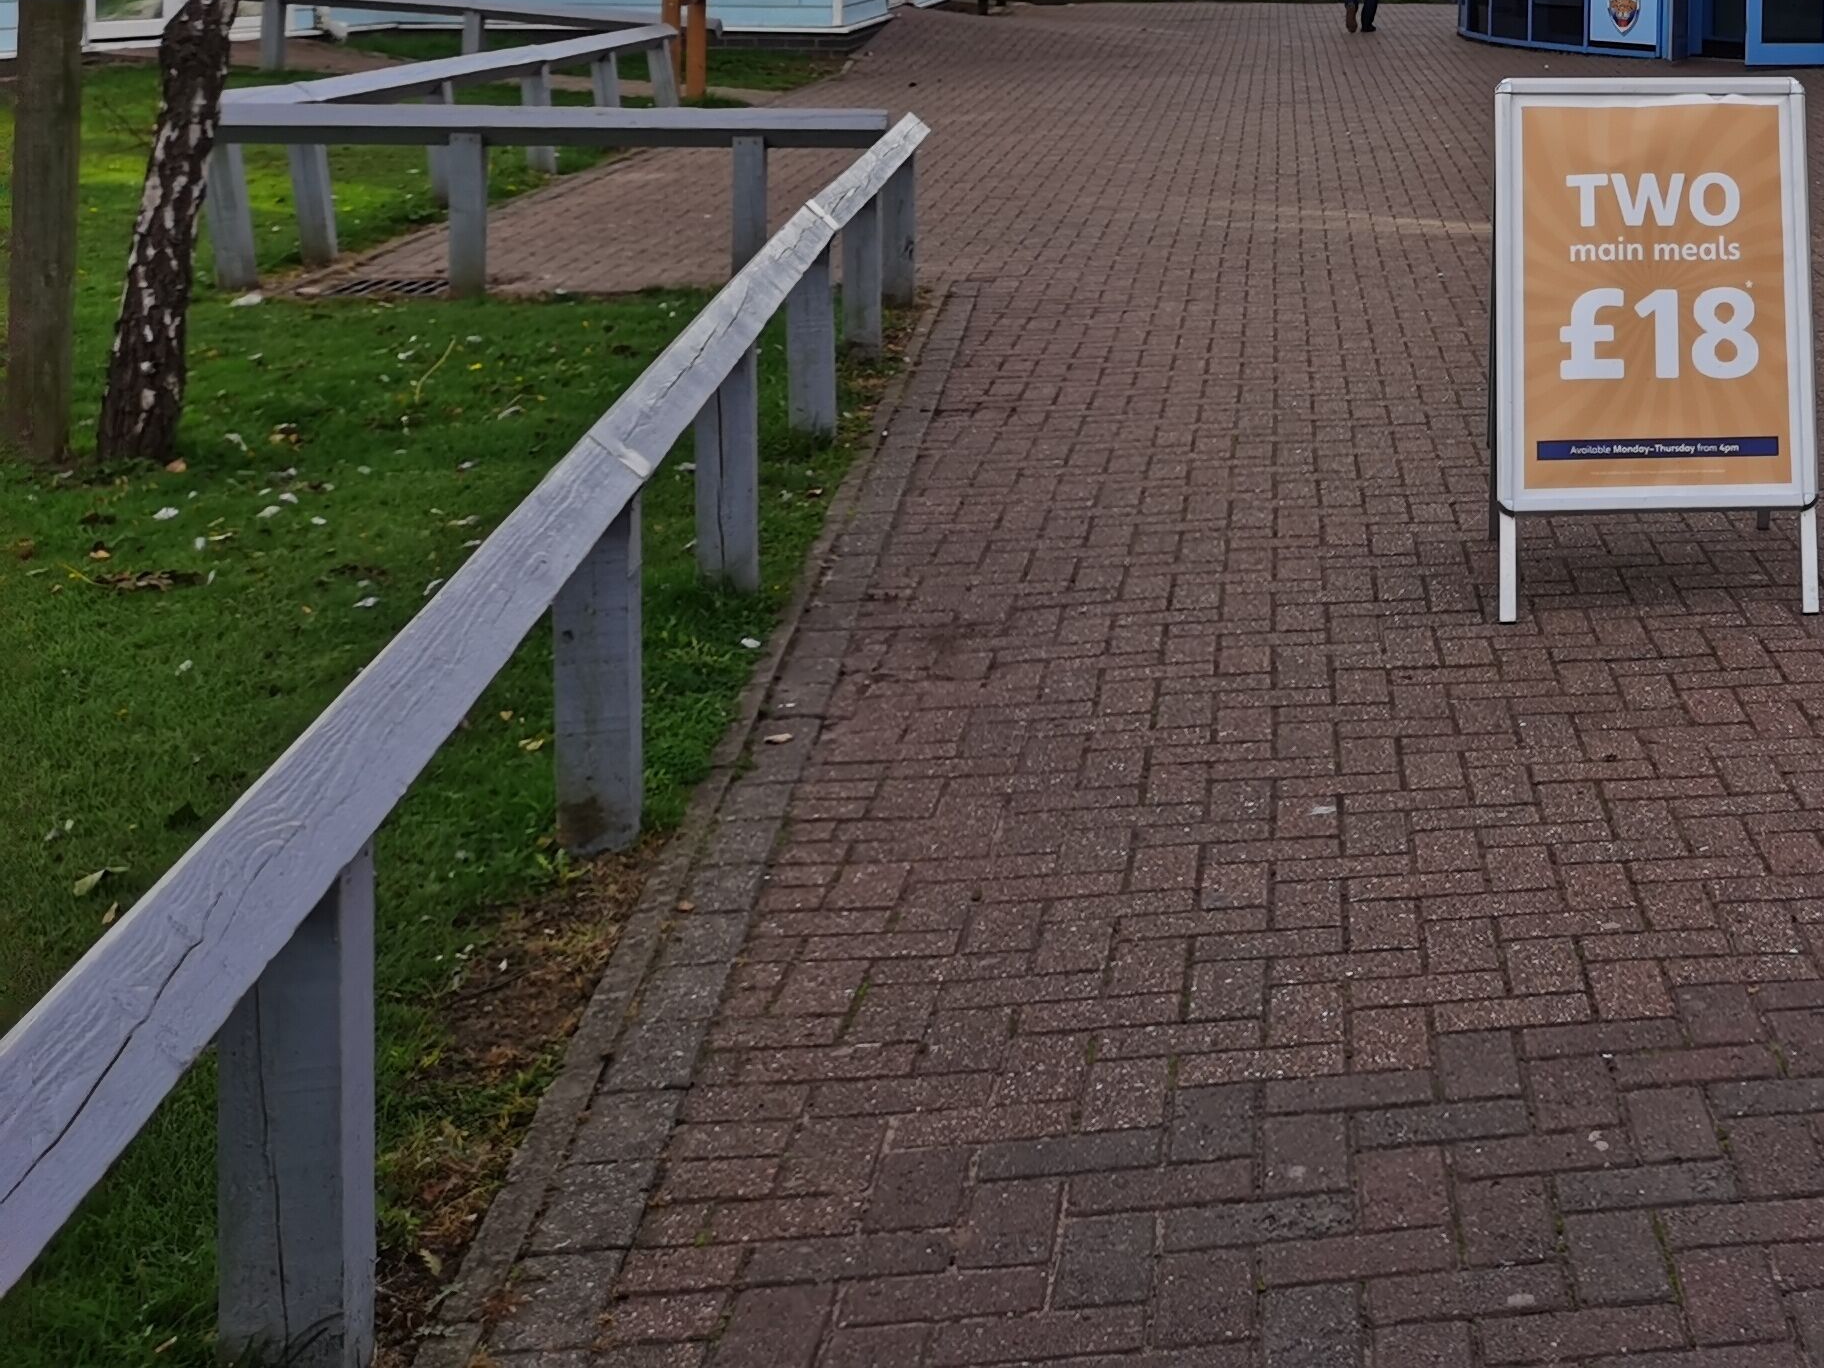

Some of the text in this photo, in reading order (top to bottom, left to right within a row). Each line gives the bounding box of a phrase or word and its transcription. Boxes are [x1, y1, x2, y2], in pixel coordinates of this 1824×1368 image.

[1565, 172, 1741, 227] TWO
[1569, 235, 1741, 262] main meals
[1569, 445, 1611, 455] Available
[1697, 443, 1718, 453] from
[1719, 443, 1740, 454] 4pm
